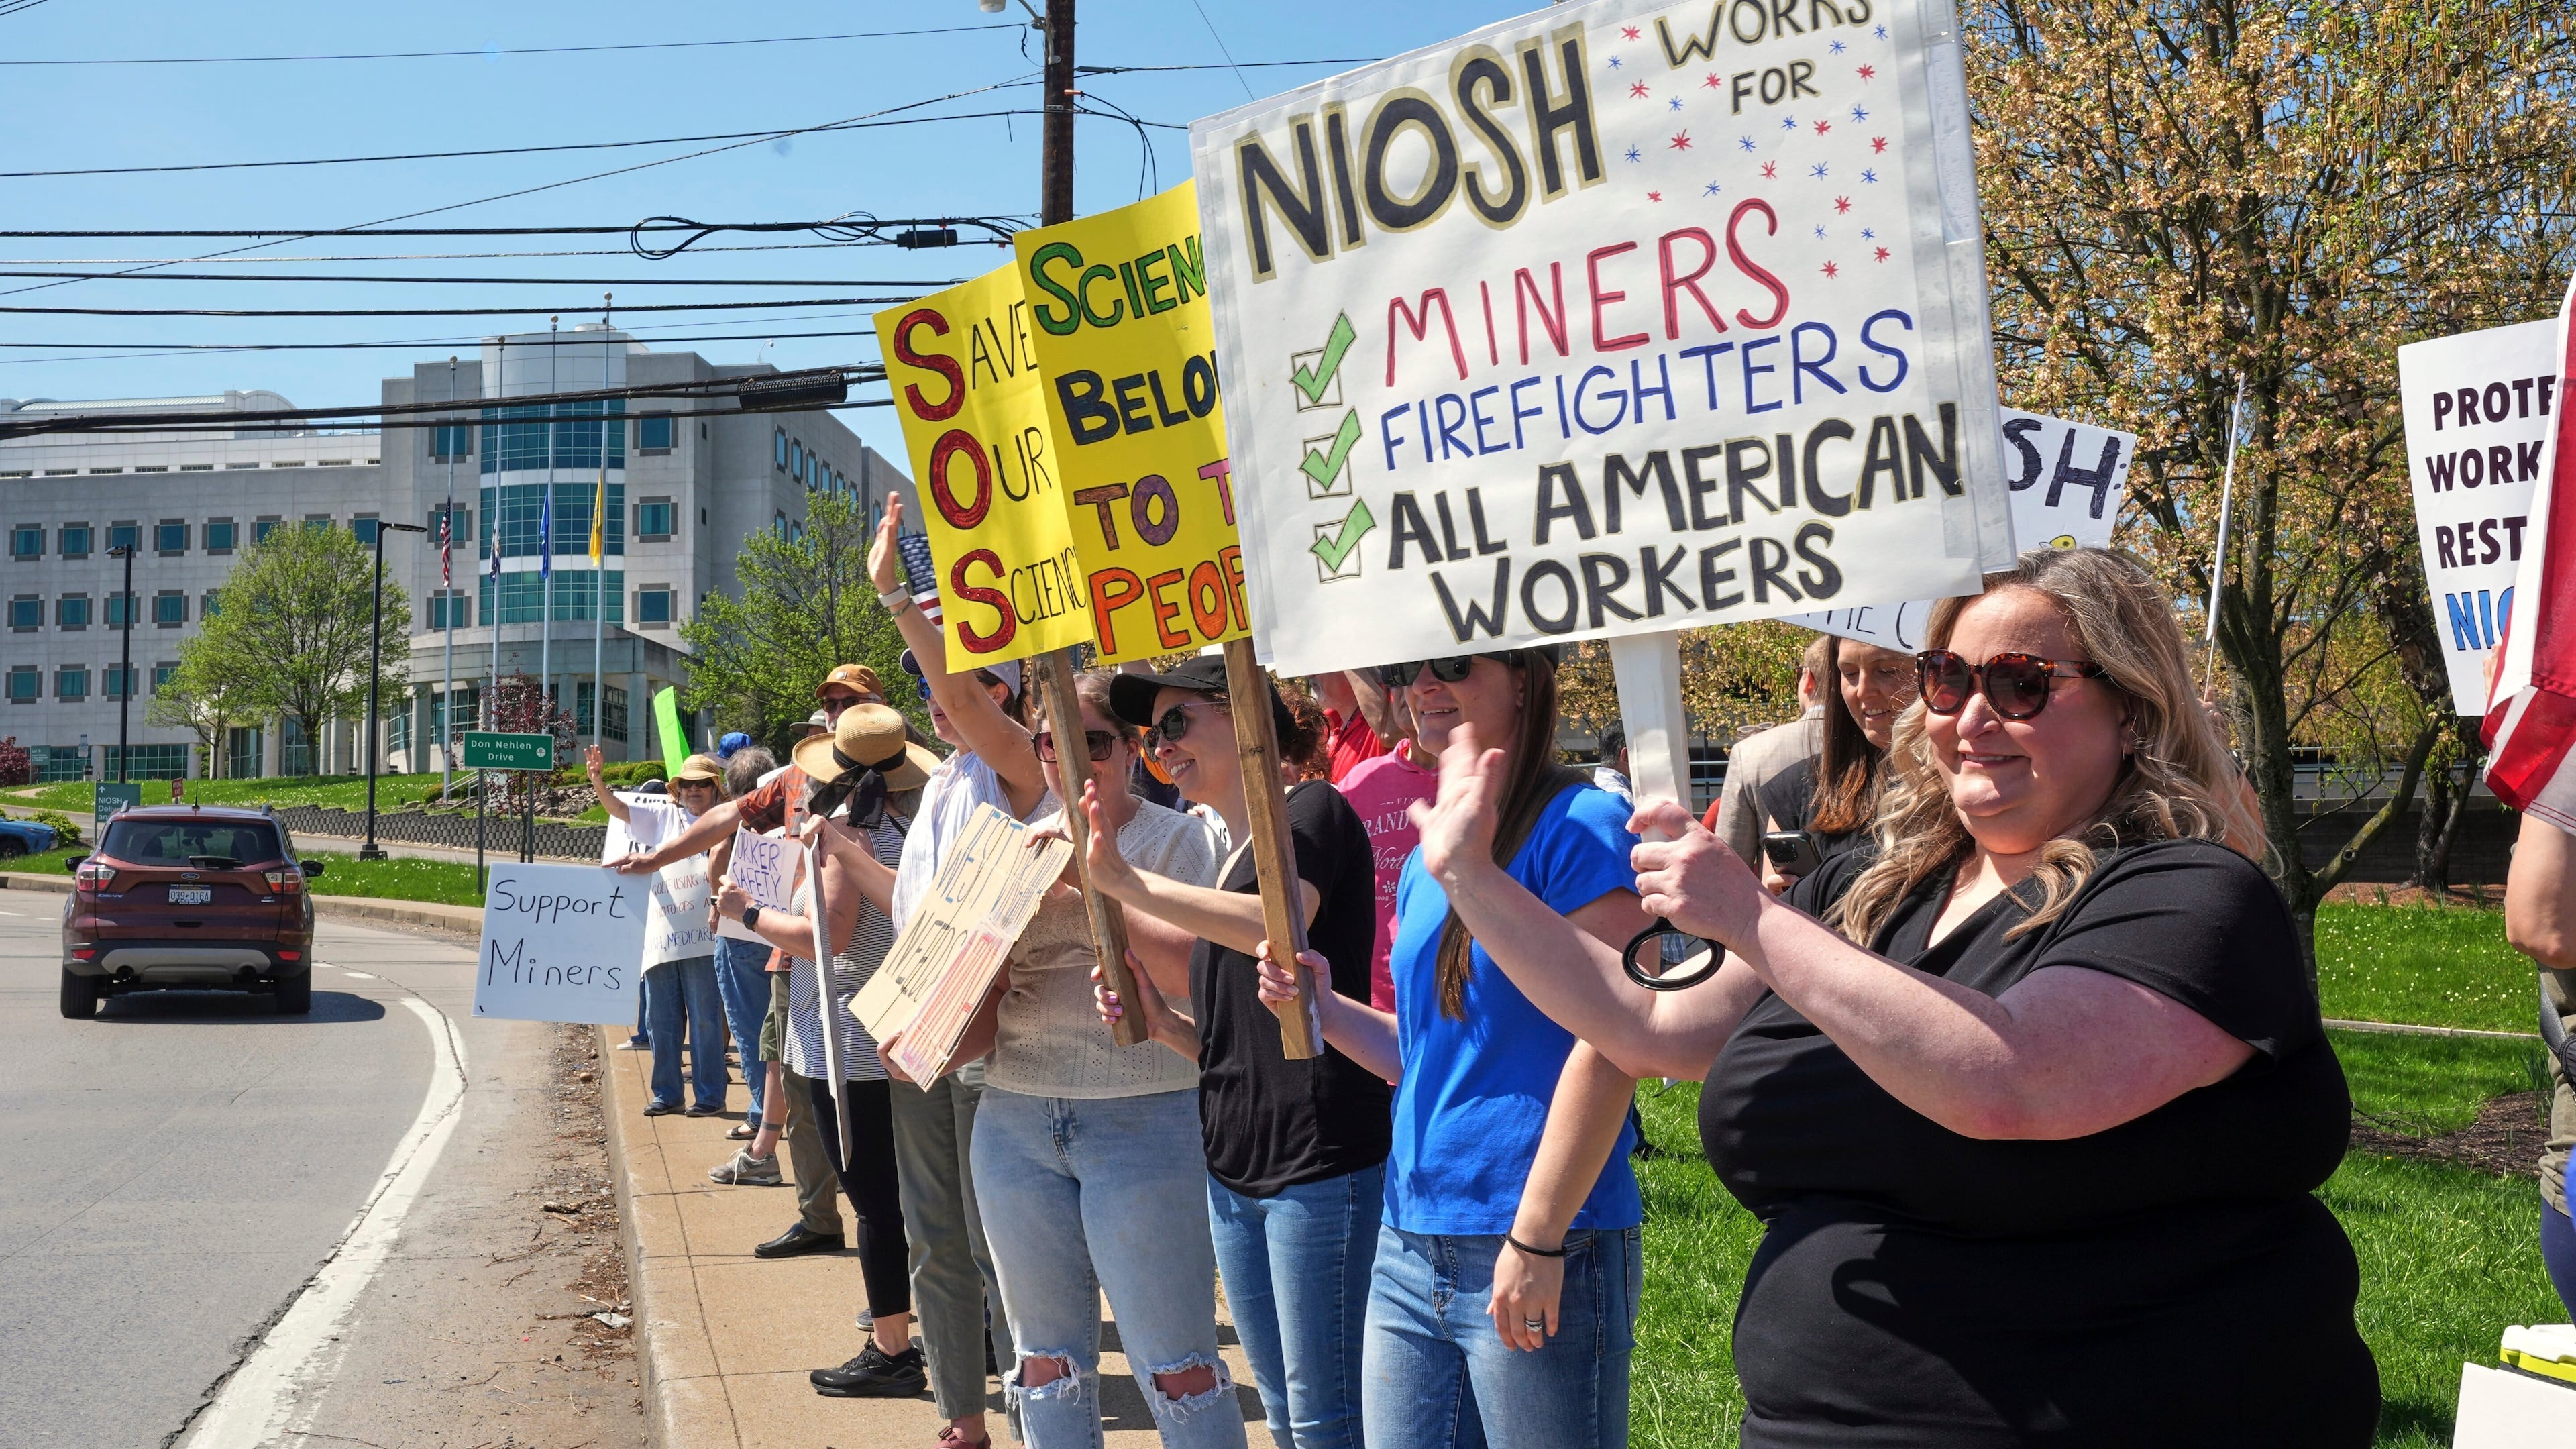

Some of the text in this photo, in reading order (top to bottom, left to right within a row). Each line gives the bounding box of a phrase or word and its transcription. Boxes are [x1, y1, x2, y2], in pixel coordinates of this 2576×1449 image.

[1731, 59, 1821, 116] FOR
[1233, 20, 1607, 284] NIOSH
[1030, 233, 1208, 335] SCIEN
[1385, 198, 1790, 387] MINERS
[894, 299, 1038, 421] SAVE
[1055, 350, 1222, 446] BELO
[1381, 309, 1913, 470] FIREFIGHTERS
[929, 426, 1052, 529] OUR
[1074, 474, 1179, 551] TO
[1387, 401, 1965, 571] ALL AMERICAN
[1430, 518, 1843, 644] WORKERS
[471, 740, 531, 749] Don Nehlen
[488, 753, 515, 761] Drive
[98, 796, 123, 804] NIOSH
[494, 879, 625, 924] Support
[732, 861, 781, 902] SAFETY
[488, 938, 621, 991] Miners
[885, 908, 968, 1002] NEEDS
